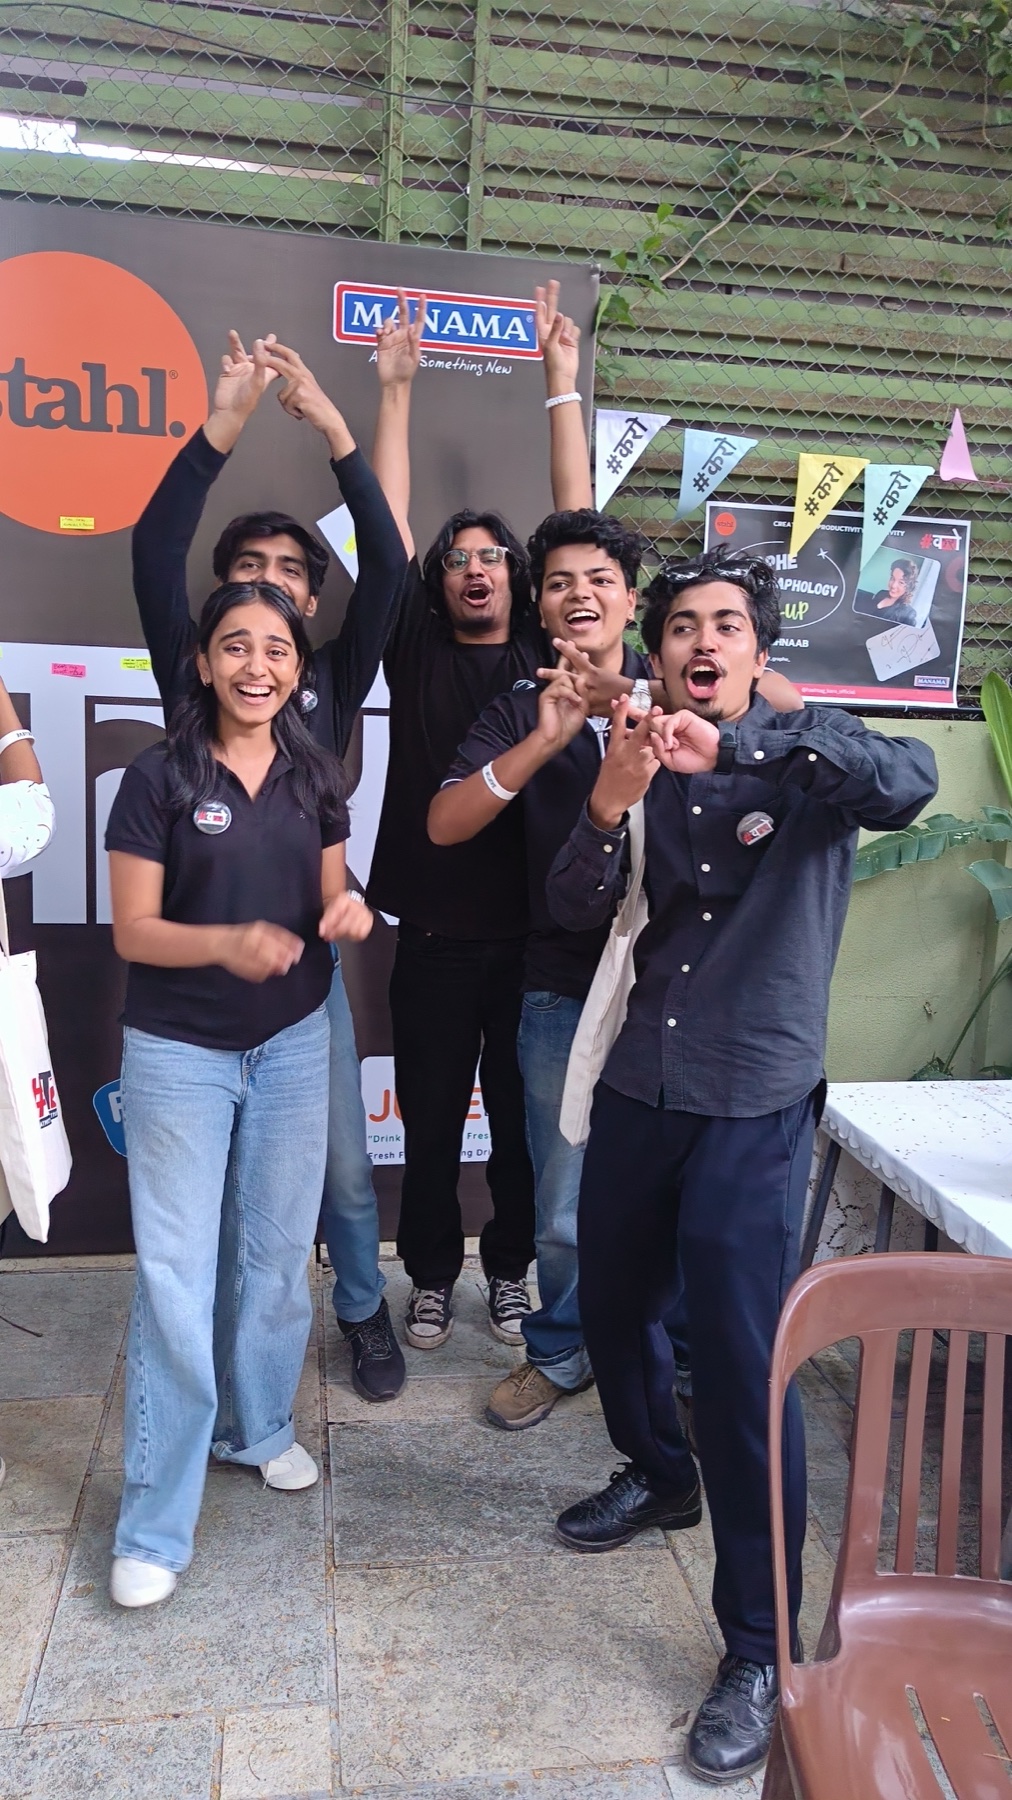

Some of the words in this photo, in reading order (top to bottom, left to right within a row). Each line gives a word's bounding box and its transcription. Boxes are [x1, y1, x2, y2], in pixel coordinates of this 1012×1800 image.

[419, 354, 482, 377] Something
[486, 359, 512, 375] New
[0, 357, 187, 438] tahl.
[606, 416, 648, 475] #करो
[692, 437, 737, 493] #करो
[804, 461, 844, 516] #करो
[872, 470, 911, 526] #करो
[369, 1151, 395, 1159] Fresh
[467, 1132, 489, 1140] Fres
